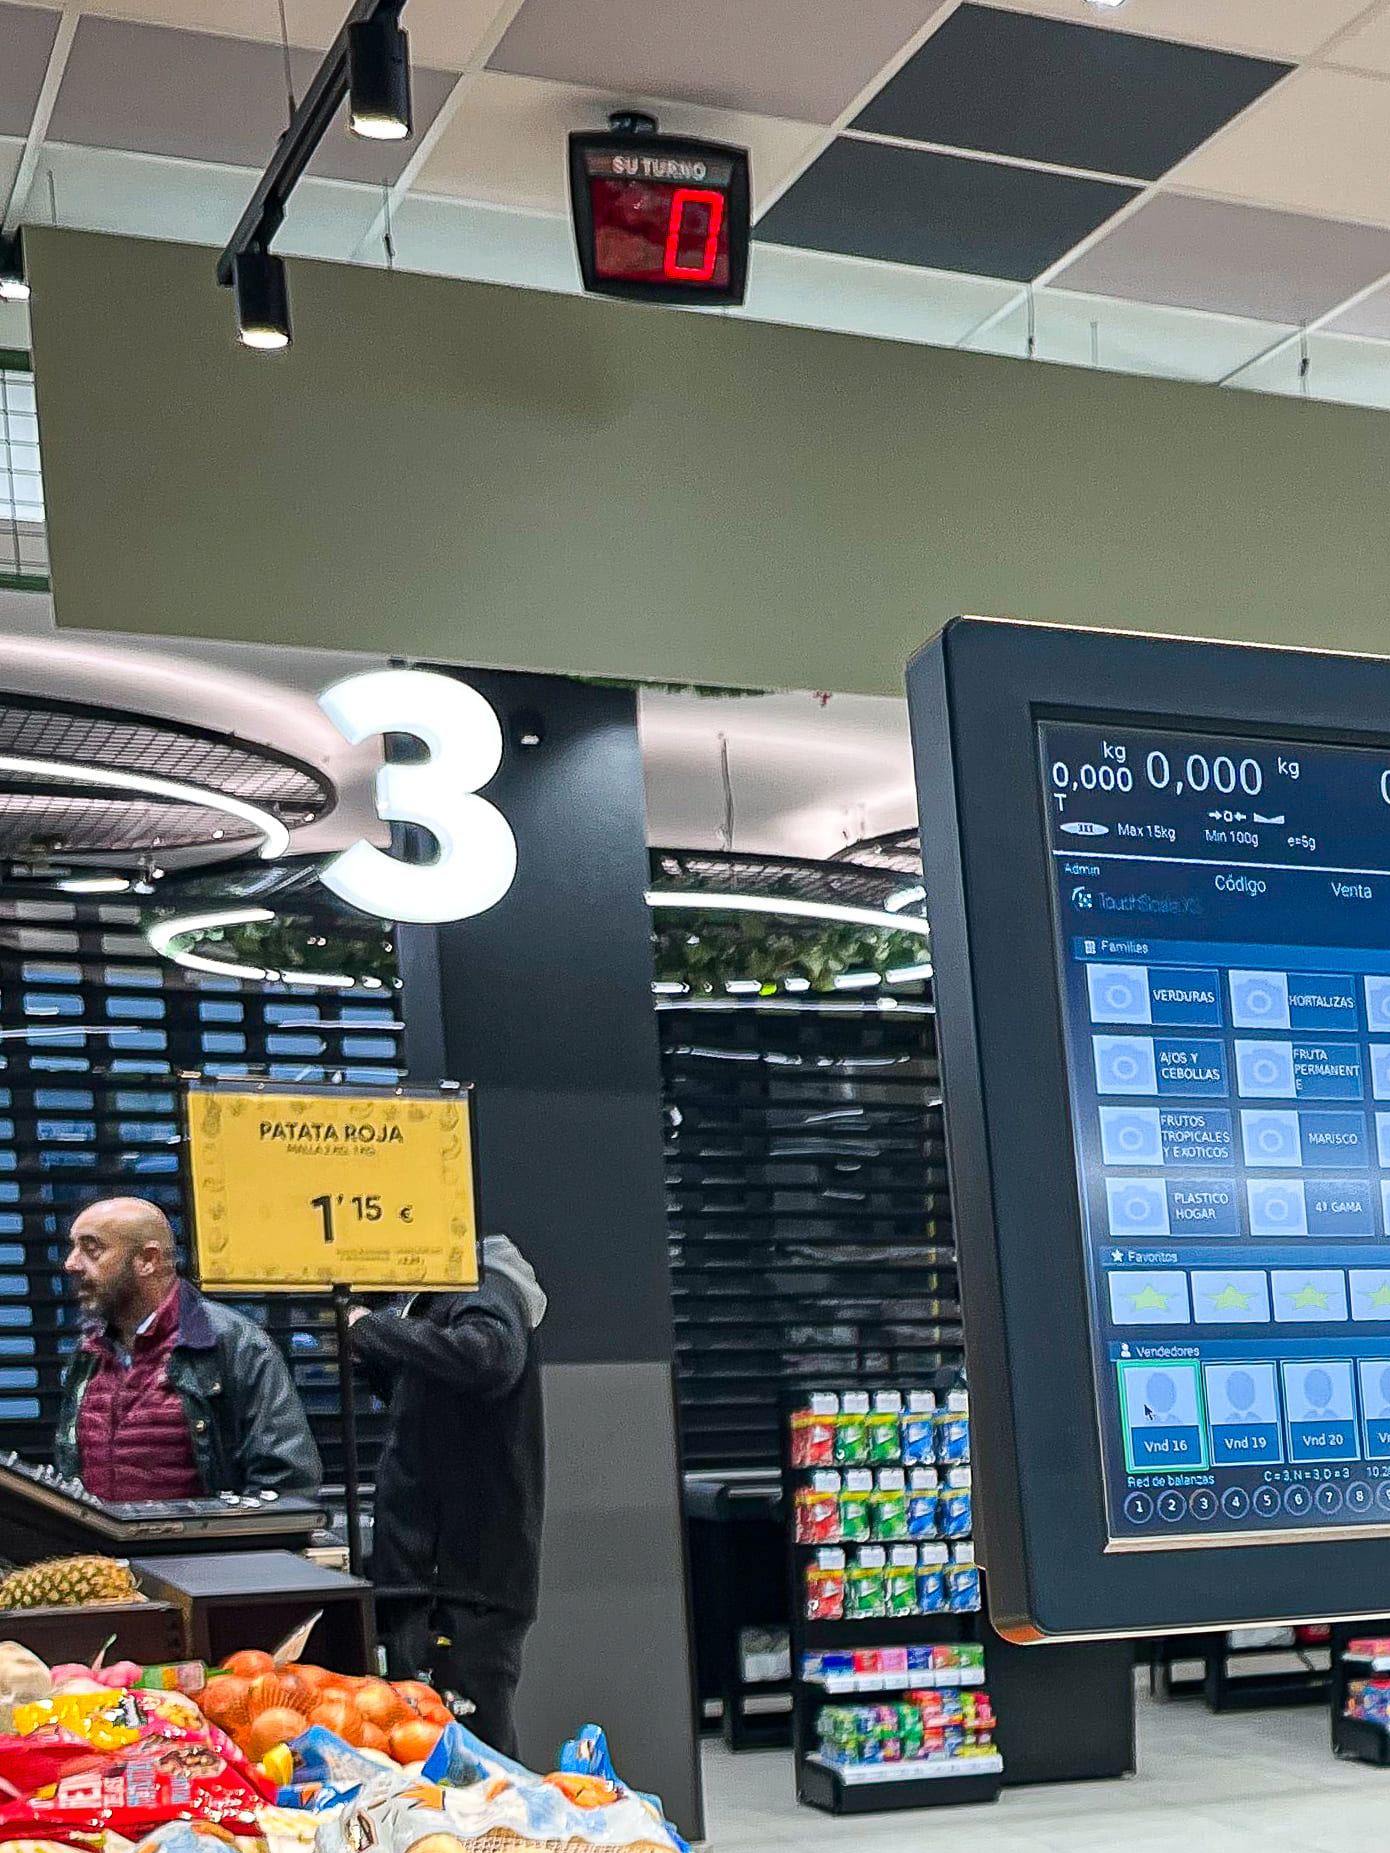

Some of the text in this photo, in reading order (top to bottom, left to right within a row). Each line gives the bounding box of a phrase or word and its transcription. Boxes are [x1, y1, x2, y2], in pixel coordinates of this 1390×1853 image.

[612, 155, 707, 182] SU TURNO
[664, 189, 724, 281] 0
[1103, 741, 1126, 763] kg
[1146, 751, 1300, 796] 0,000 kg
[1053, 762, 1133, 811] 0,000 T
[318, 669, 517, 924] 3
[1118, 823, 1176, 843] Max 15kg
[1204, 829, 1259, 848] Min 100g
[1215, 874, 1267, 897] Código
[1331, 881, 1373, 899] Venta
[1153, 989, 1215, 1003] VERDURAS
[1289, 995, 1354, 1010] HORTALIZAS
[1160, 1052, 1198, 1065] AJOS Y
[1294, 1049, 1328, 1061] FRUTA
[1161, 1067, 1220, 1080] CEBOLLAS
[1294, 1063, 1360, 1077] PERMANENT
[1295, 1079, 1302, 1090] E
[1160, 1115, 1206, 1127] FRUTOS
[259, 1120, 404, 1145] PATATA ROJA
[1161, 1130, 1230, 1143] TROPICALES
[1308, 1133, 1358, 1145] MARISCO
[1163, 1147, 1229, 1159] Y EXOTICOS
[1174, 1193, 1229, 1205] PLASTICO
[1330, 1201, 1362, 1213] GAMA
[400, 1205, 414, 1223] €
[1176, 1208, 1216, 1220] HOGAR
[1127, 1251, 1178, 1264] Favoritos
[1135, 1345, 1200, 1358] Vendedores
[1144, 1440, 1188, 1453] Vnd 16
[1225, 1437, 1267, 1450] Vnd 19
[1303, 1434, 1344, 1447] Vnd 20
[1127, 1476, 1150, 1488] Red
[1152, 1476, 1166, 1487] de
[1135, 1501, 1143, 1512] 1
[1168, 1500, 1176, 1511] 2
[1200, 1498, 1208, 1510] 3
[1232, 1496, 1240, 1508] 4
[1263, 1494, 1271, 1506] 5
[1295, 1493, 1303, 1505] 6
[1325, 1492, 1333, 1503] 7
[1356, 1490, 1364, 1502] 8
